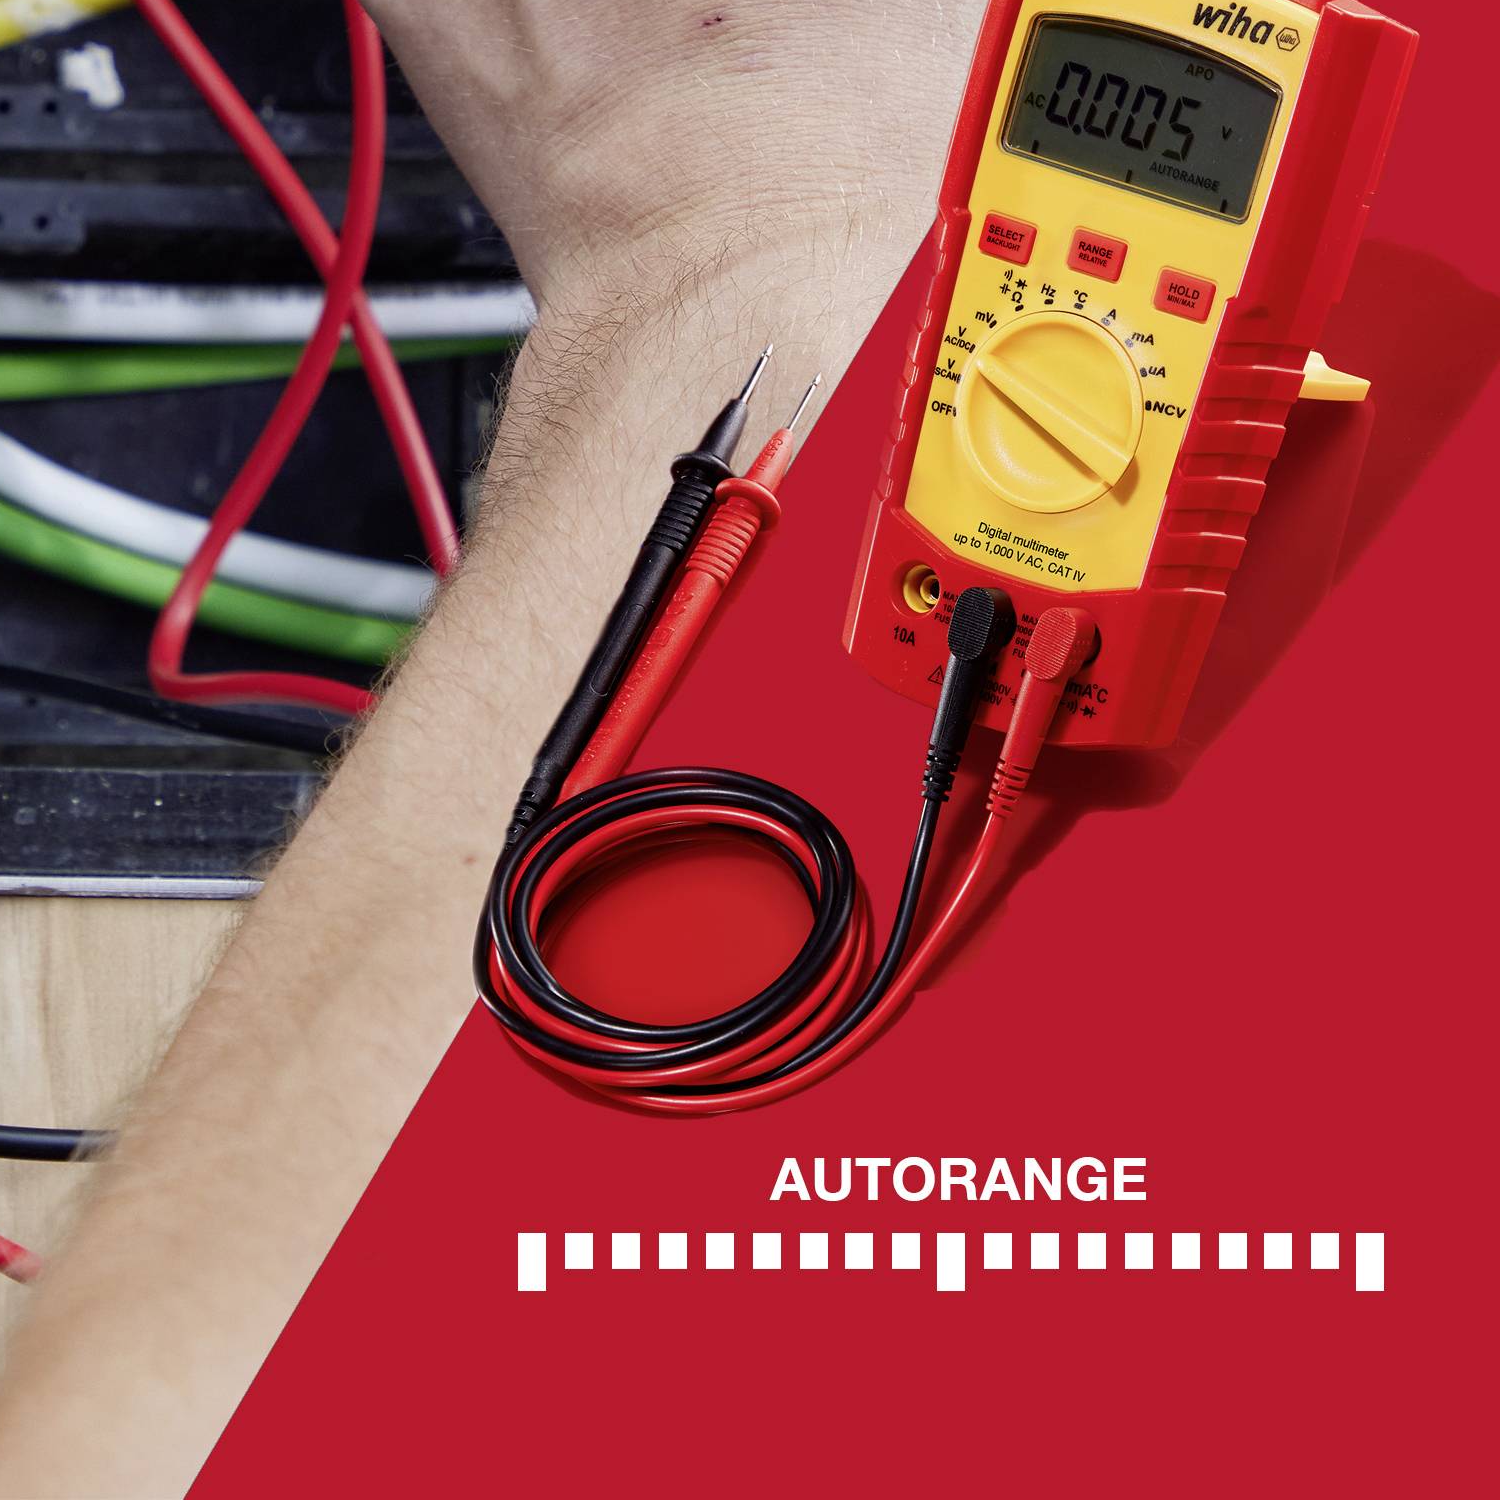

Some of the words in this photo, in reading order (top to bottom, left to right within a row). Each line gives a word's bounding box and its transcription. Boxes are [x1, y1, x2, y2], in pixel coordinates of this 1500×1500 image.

[1192, 2, 1275, 45] wiha
[1185, 63, 1214, 81] APO
[1025, 91, 1046, 109] AC
[1045, 60, 1203, 162] 0.005
[1149, 161, 1220, 192] AUTORANGE
[988, 224, 1025, 243] SELECT
[986, 235, 1021, 252] BACKLIGHT
[1078, 241, 1113, 260] RANGE
[1078, 252, 1107, 268] RELATIVE
[1040, 283, 1056, 298] Hz
[1169, 283, 1200, 300] HOLD
[975, 311, 993, 326] mV
[1106, 308, 1117, 320] A
[958, 326, 967, 337] V
[1131, 331, 1154, 345] mA
[944, 334, 971, 351] AC/DC
[947, 358, 956, 369] V
[934, 366, 958, 383] SCAN
[931, 401, 953, 416] OFF
[1152, 402, 1186, 418] NCV
[978, 521, 1012, 542] Digital
[1013, 535, 1069, 561] multimeter
[954, 532, 968, 545] up
[970, 537, 981, 548] to
[985, 542, 1014, 560] 1,000
[1016, 552, 1026, 562] V
[1027, 556, 1044, 571] AC,
[1048, 562, 1073, 578] CAT
[1074, 570, 1086, 583] IV
[893, 626, 915, 646] 10A
